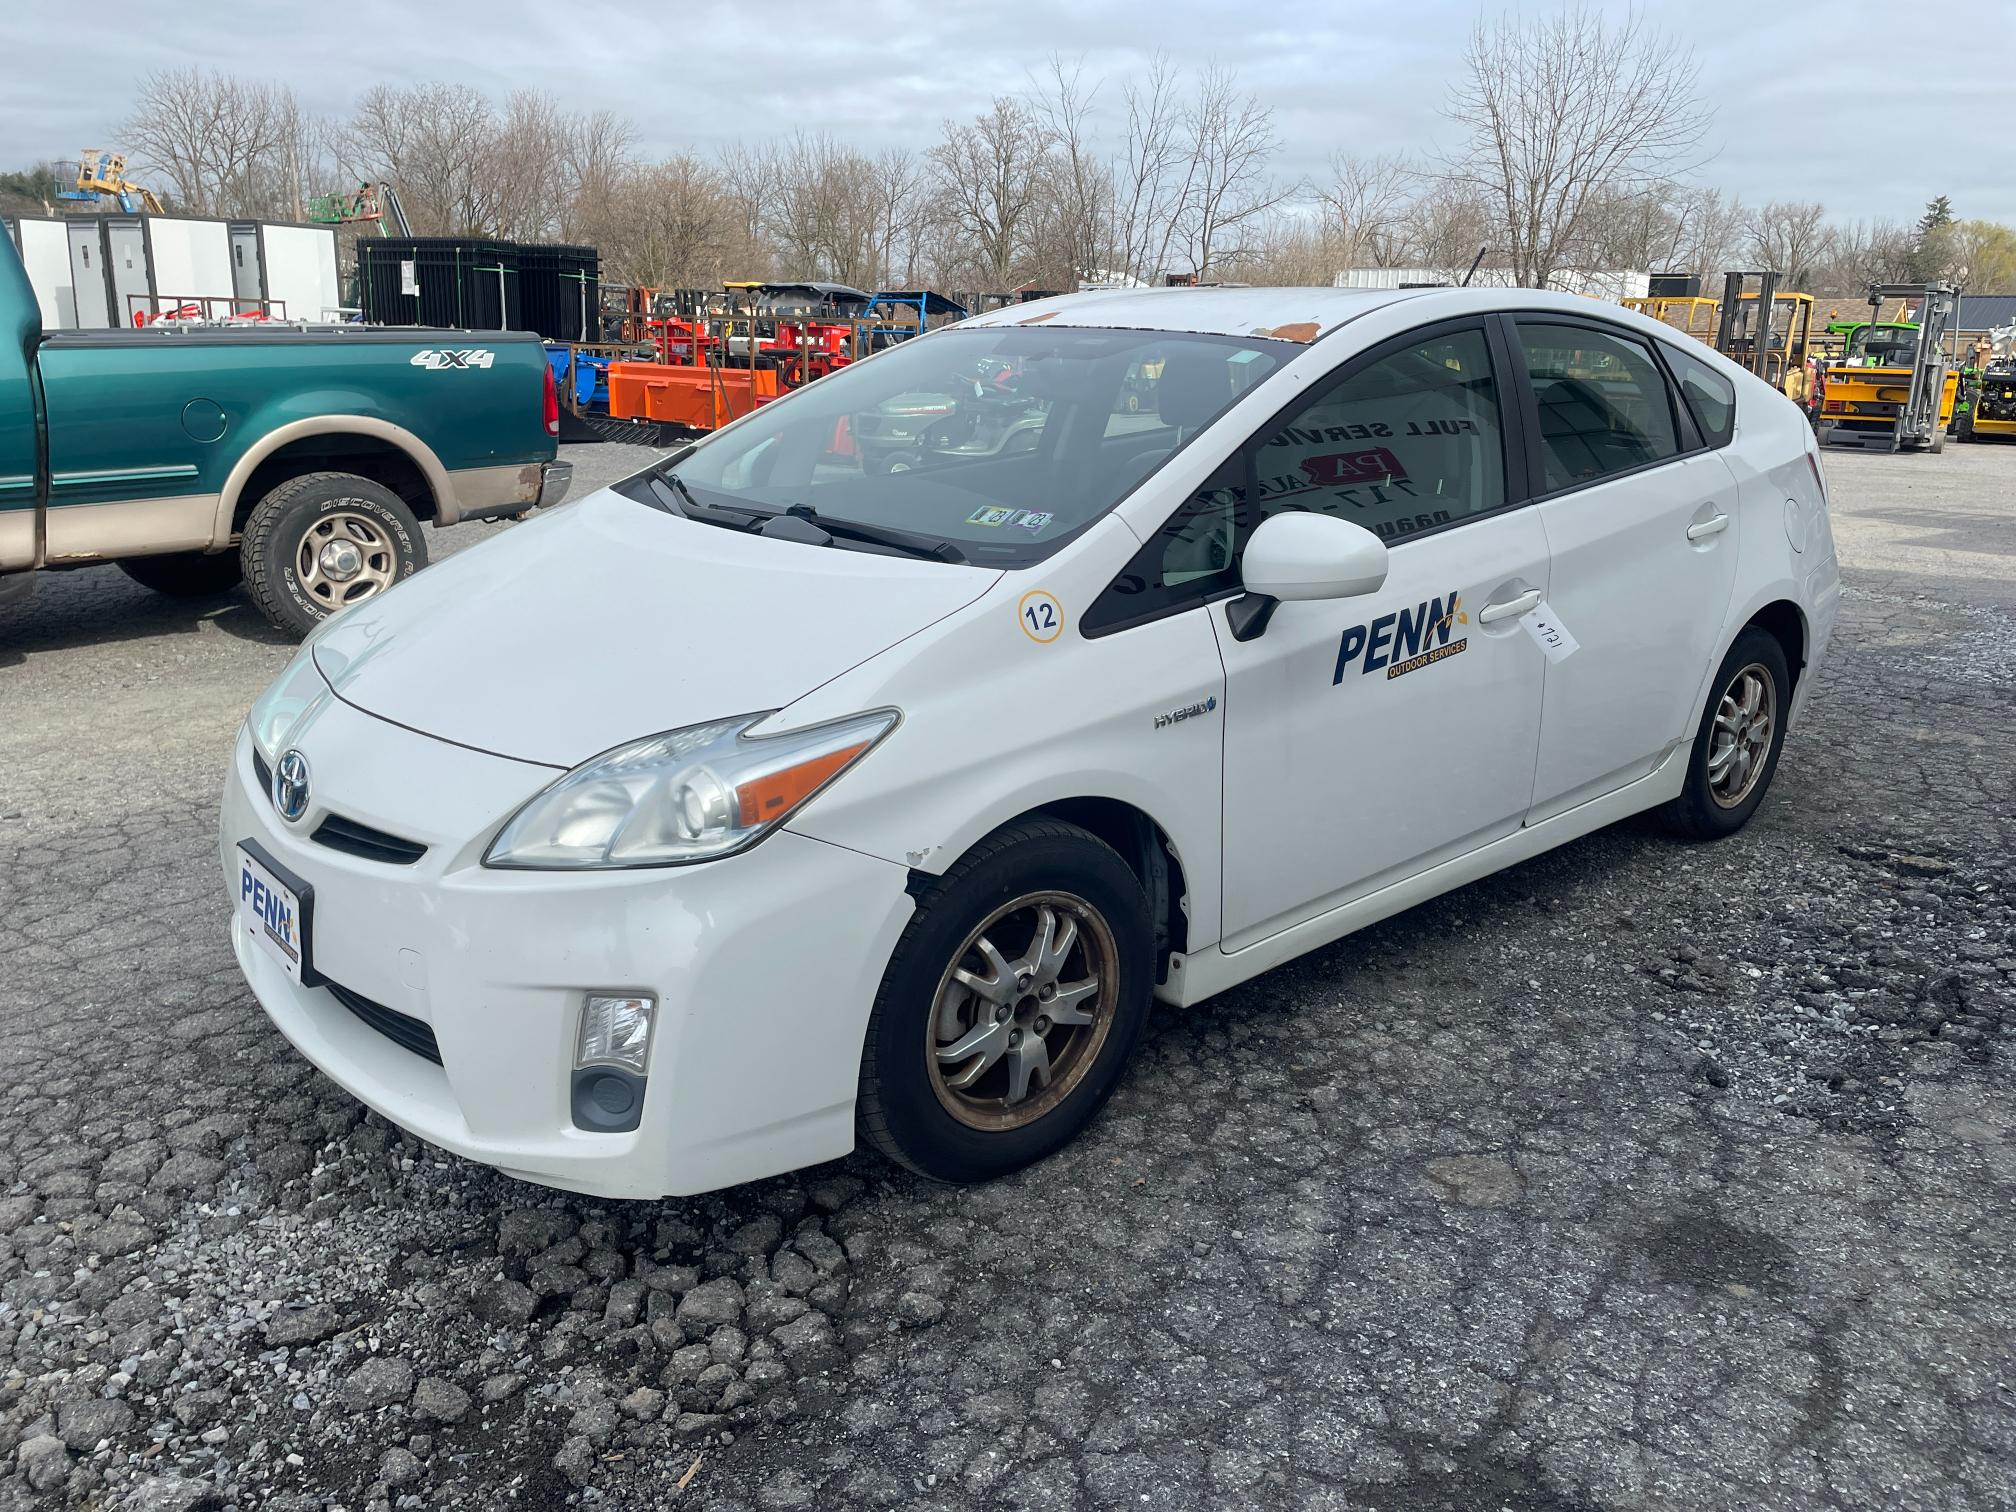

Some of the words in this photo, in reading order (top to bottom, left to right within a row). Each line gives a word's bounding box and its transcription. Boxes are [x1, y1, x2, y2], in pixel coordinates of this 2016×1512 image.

[410, 350, 495, 369] 4X4
[321, 497, 413, 554] DISCOVERER
[284, 566, 328, 621] OOPER
[1026, 603, 1056, 630] 12
[1333, 591, 1458, 686] PENN
[1389, 656, 1428, 678] OUTDOOR
[1430, 640, 1467, 661] SERVICES
[1154, 703, 1207, 729] HYBRID
[242, 867, 291, 944] PENN
